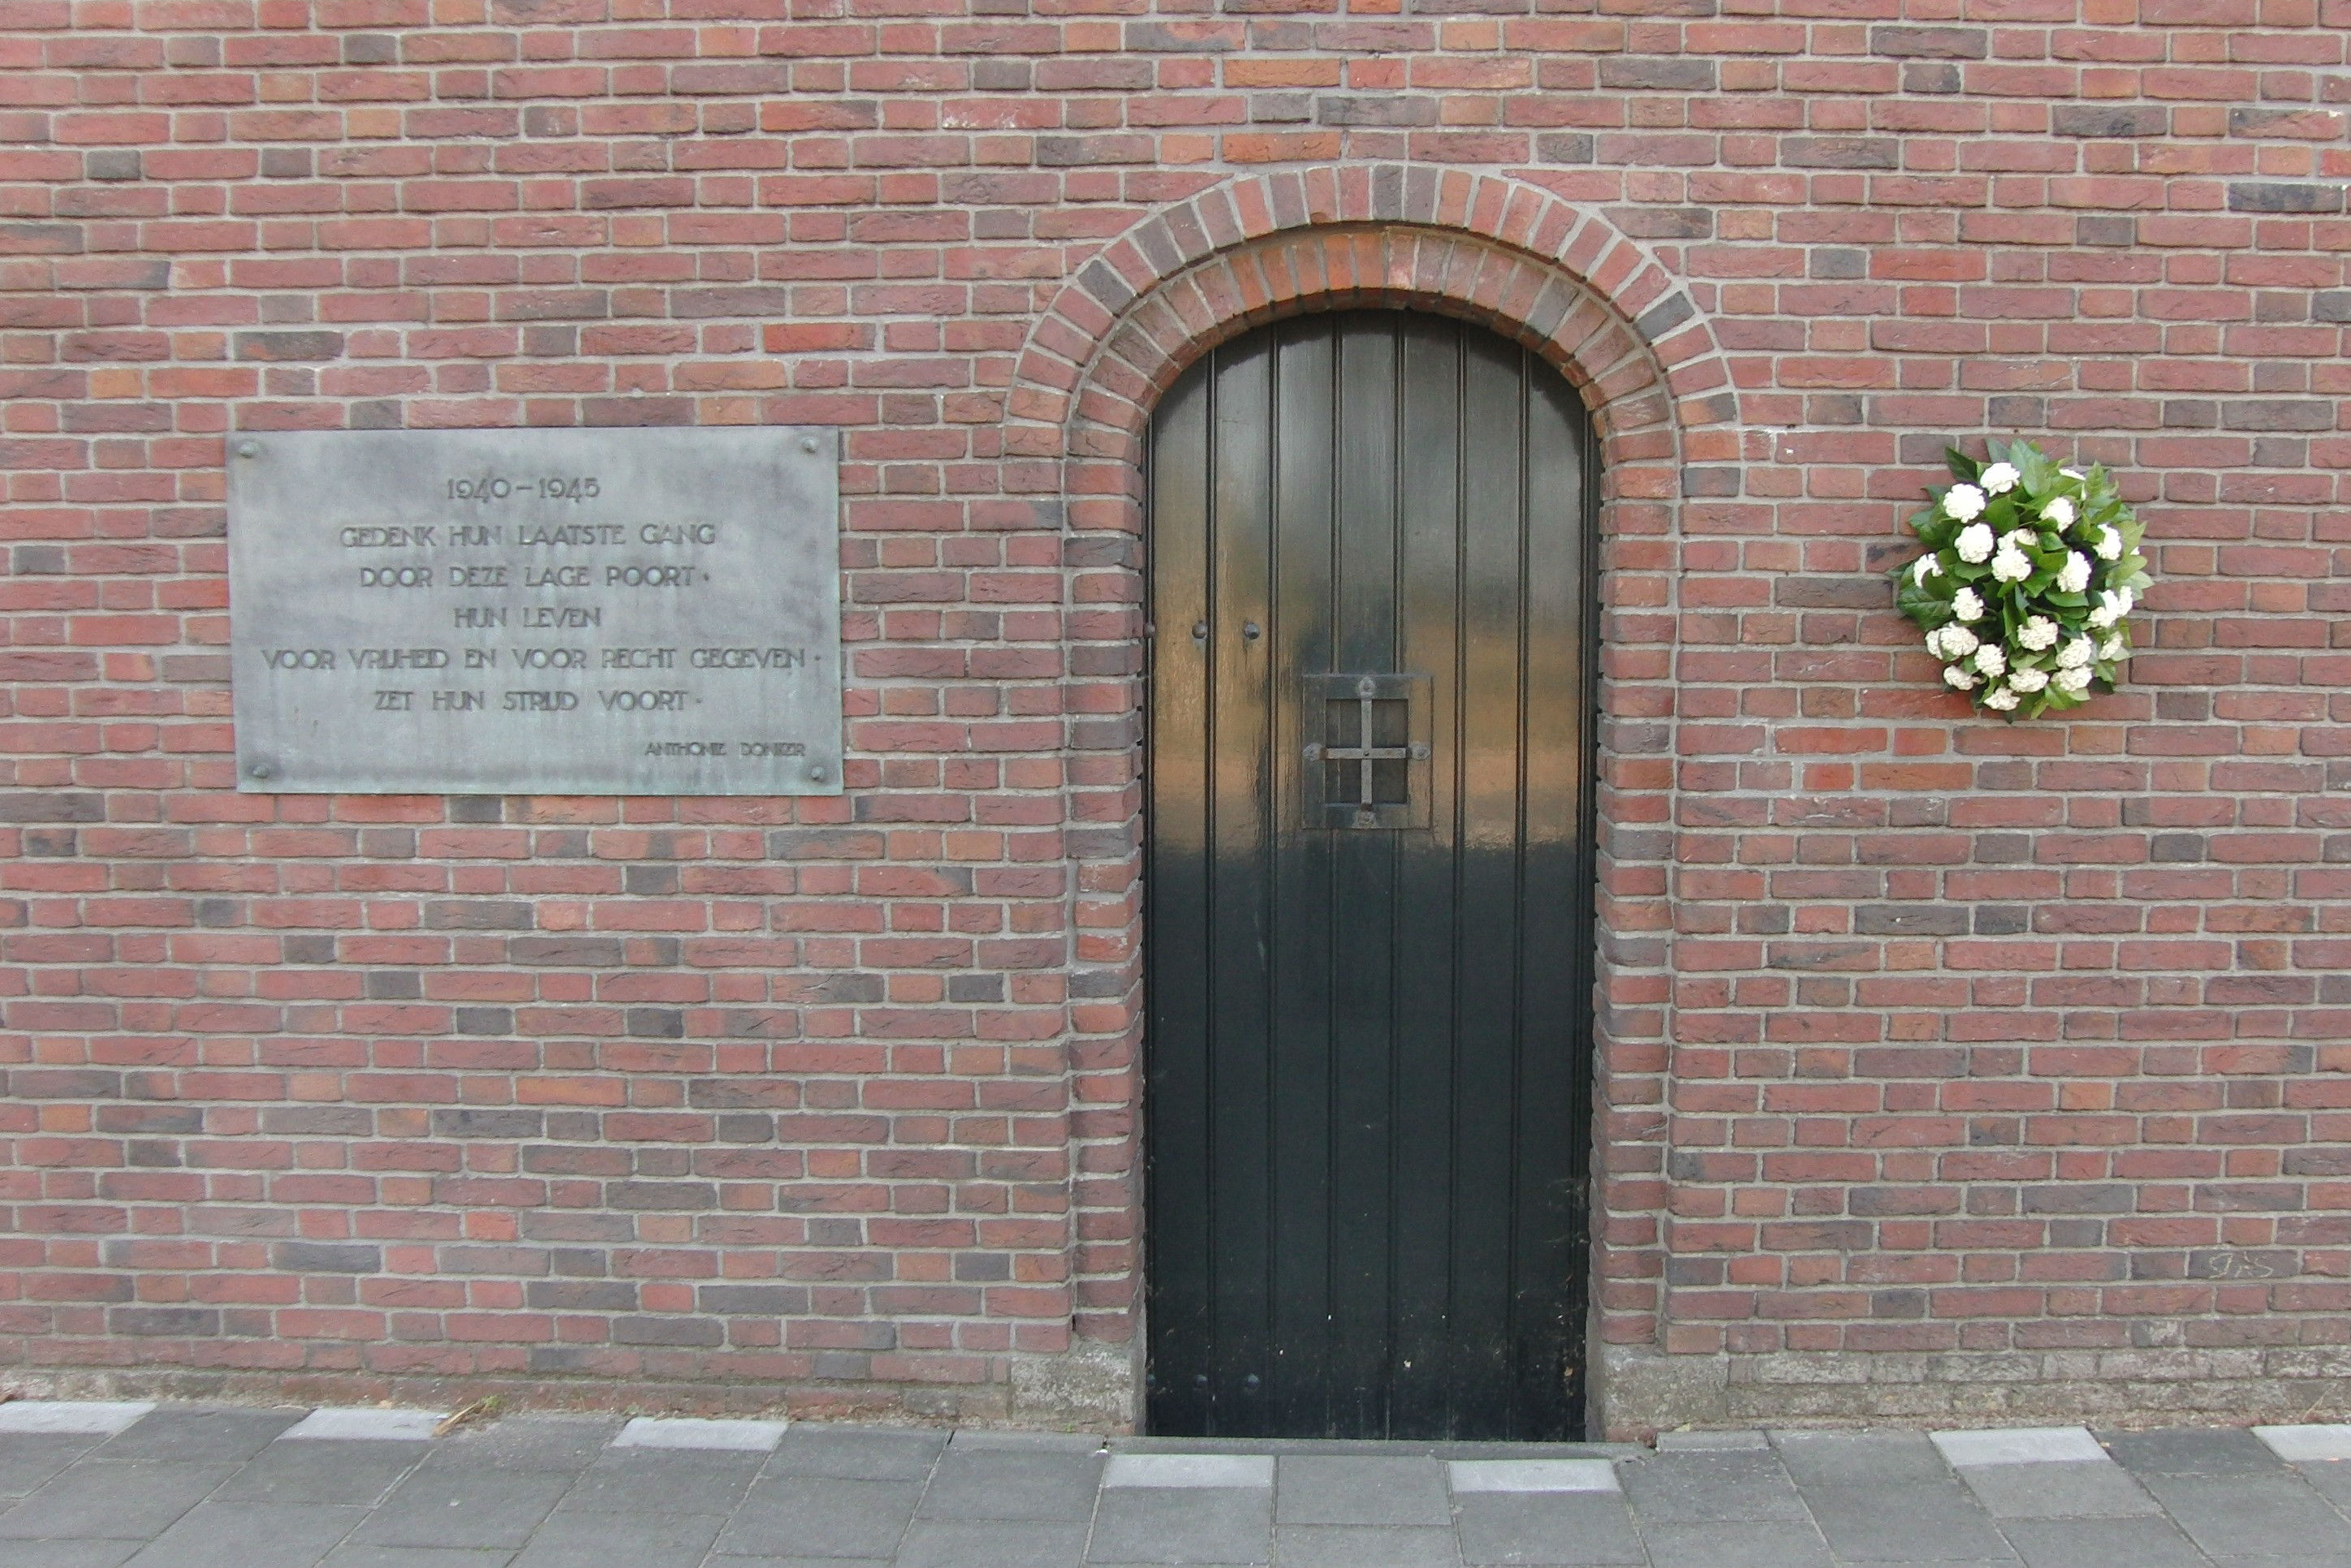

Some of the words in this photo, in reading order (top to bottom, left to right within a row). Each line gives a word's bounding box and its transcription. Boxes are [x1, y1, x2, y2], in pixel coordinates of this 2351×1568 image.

[339, 526, 436, 548] GEDENK
[449, 525, 502, 547] HUN
[519, 524, 626, 546] LAATSTE
[640, 523, 715, 545] GANG
[360, 567, 434, 588] DOOR
[449, 567, 508, 587] DEZE
[525, 566, 589, 587] LAGE
[455, 608, 507, 628] HUN
[523, 607, 601, 627] LEVEN
[261, 649, 335, 670] VOOR
[464, 648, 496, 669] EN
[511, 648, 586, 670] VOOR
[601, 648, 676, 669] RECHT
[374, 691, 413, 711] ZET
[432, 691, 485, 711] HUN
